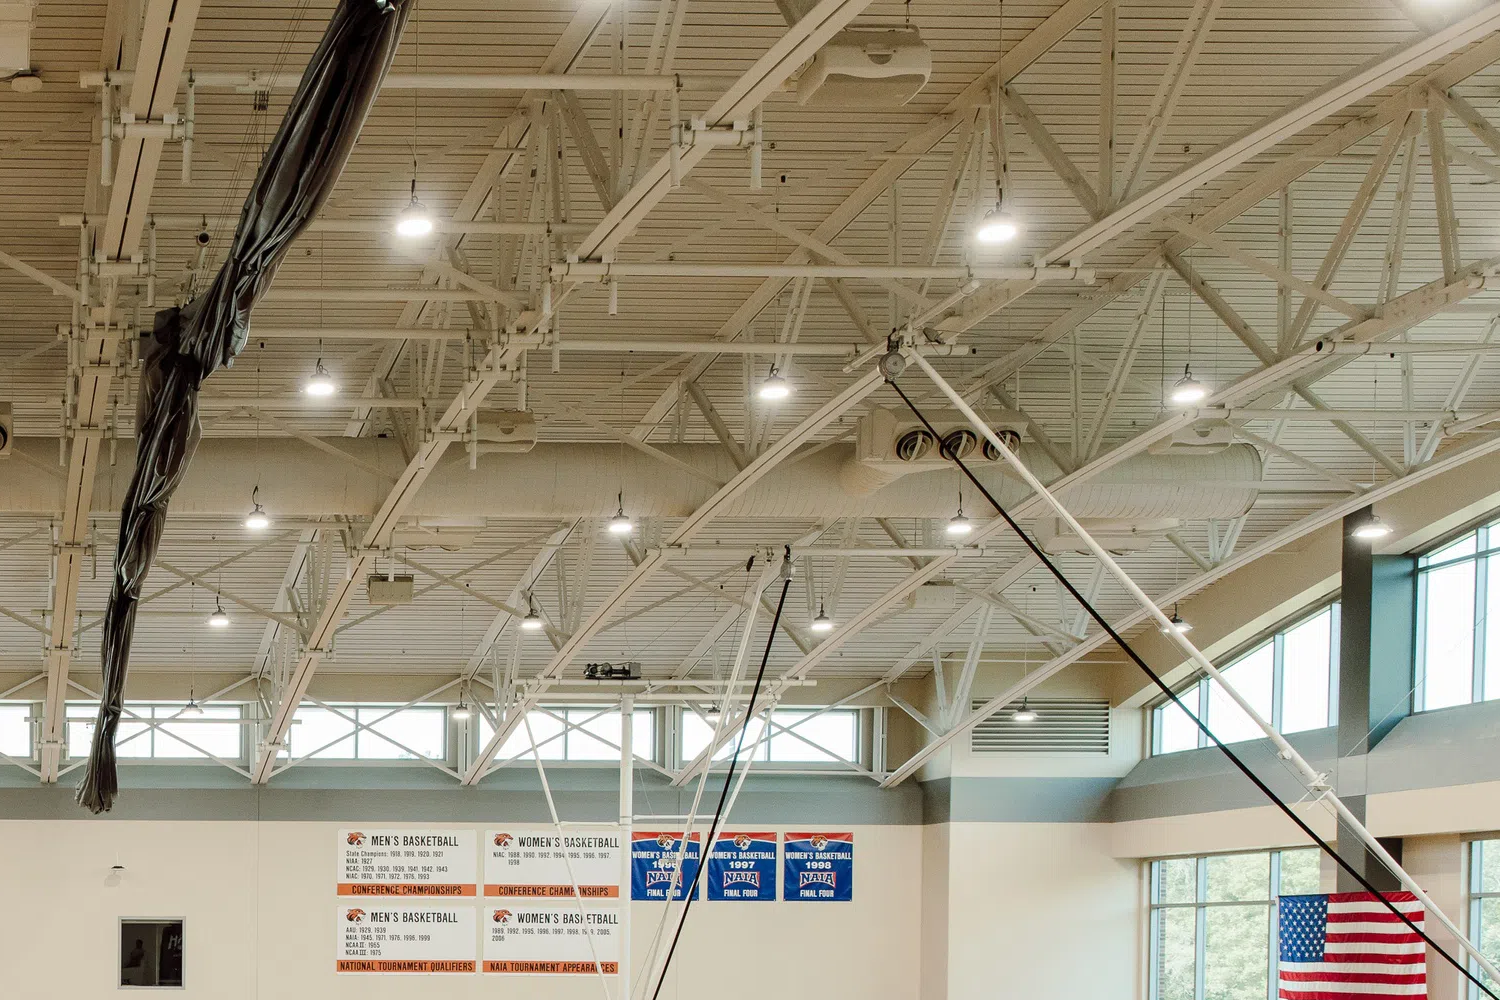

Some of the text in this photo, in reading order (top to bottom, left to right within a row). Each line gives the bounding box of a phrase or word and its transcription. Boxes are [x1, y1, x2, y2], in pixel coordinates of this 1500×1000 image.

[372, 836, 458, 846] MEN'S BASKETBALL
[519, 837, 619, 848] WOMEN'S BASKETBALL
[724, 872, 759, 885] NAIA
[800, 872, 835, 885] NAIA
[352, 886, 461, 894] CONFERENCE CHAMPIONSHIPS
[499, 887, 608, 896] CONFERENCE CHAMPONSHIPS
[371, 912, 458, 922] MEN'S BASKETBALL
[518, 913, 558, 923] WOMEN'S
[340, 962, 472, 972] NATIONAL TOURNAMENT QUALIFIERS
[490, 963, 614, 972] NAIA TOURNAMENT APPEARACES
